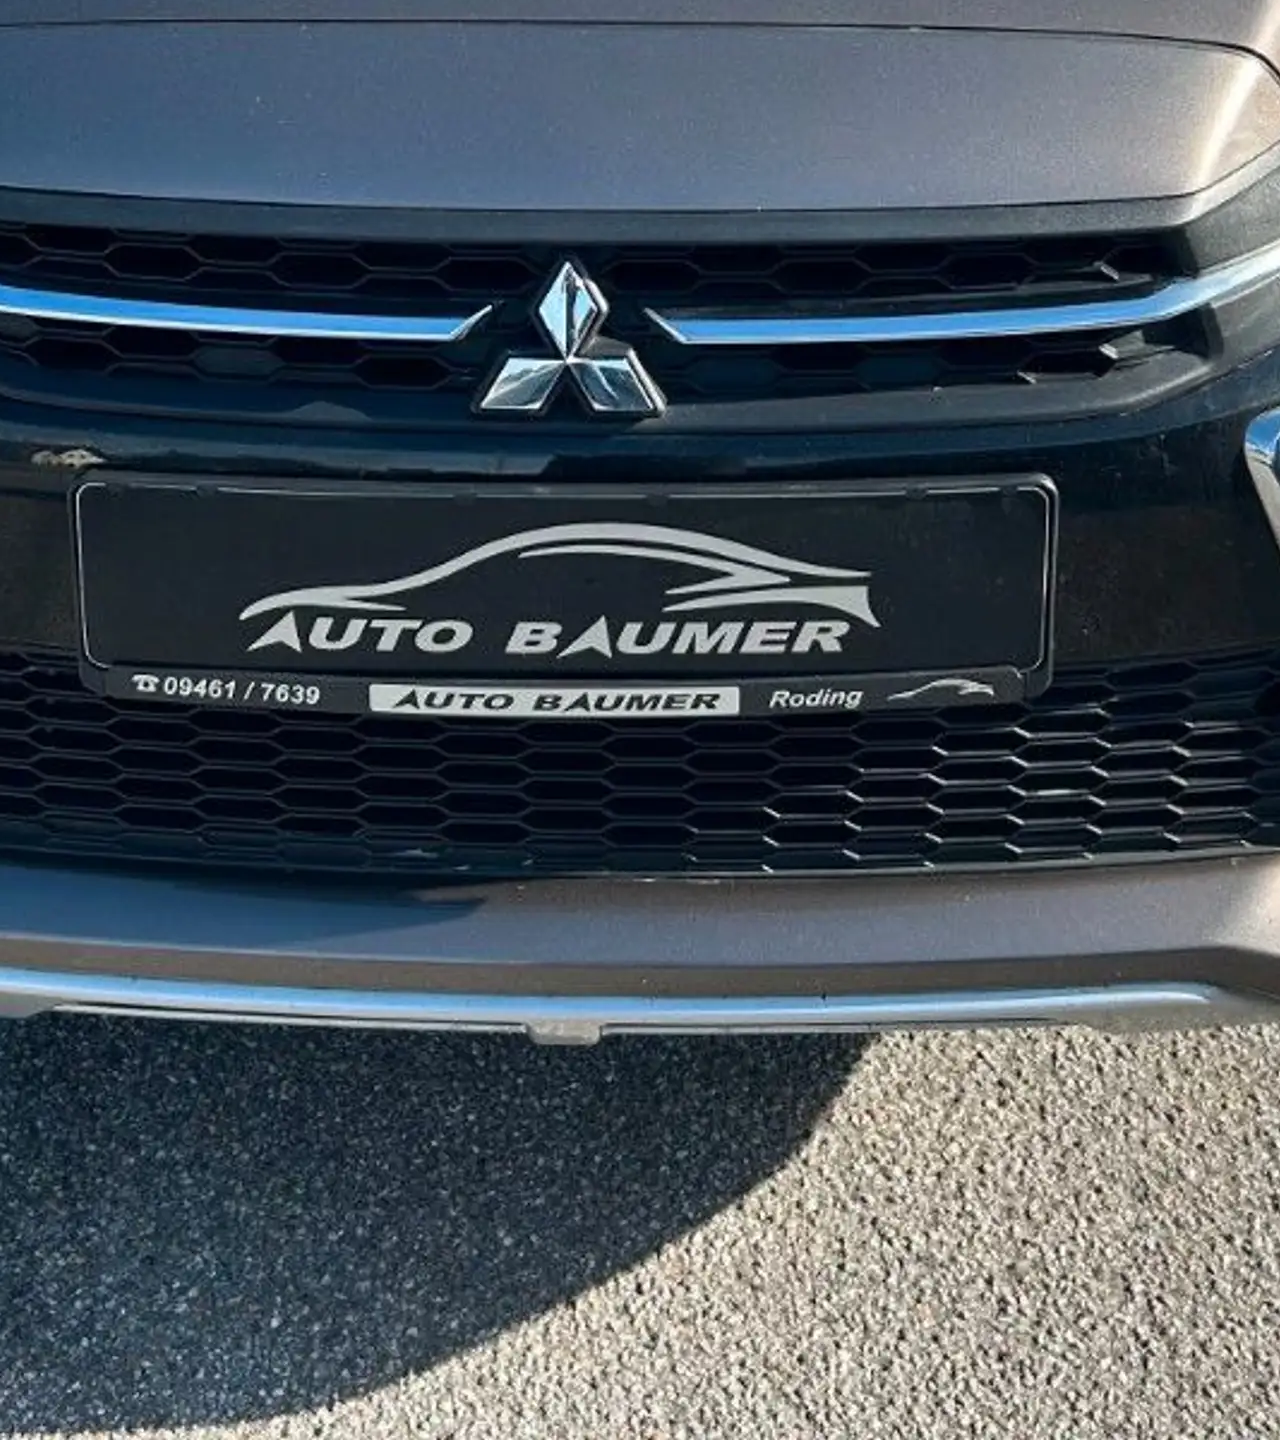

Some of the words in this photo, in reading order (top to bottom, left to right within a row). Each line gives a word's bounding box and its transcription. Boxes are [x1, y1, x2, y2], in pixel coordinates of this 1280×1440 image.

[246, 610, 474, 654] AUTO
[505, 614, 851, 659] BAUMER
[163, 675, 238, 699] 09461
[260, 681, 321, 705] 7639
[394, 689, 516, 712] AUTO
[533, 692, 722, 713] BAUMER
[769, 687, 864, 710] Roding
